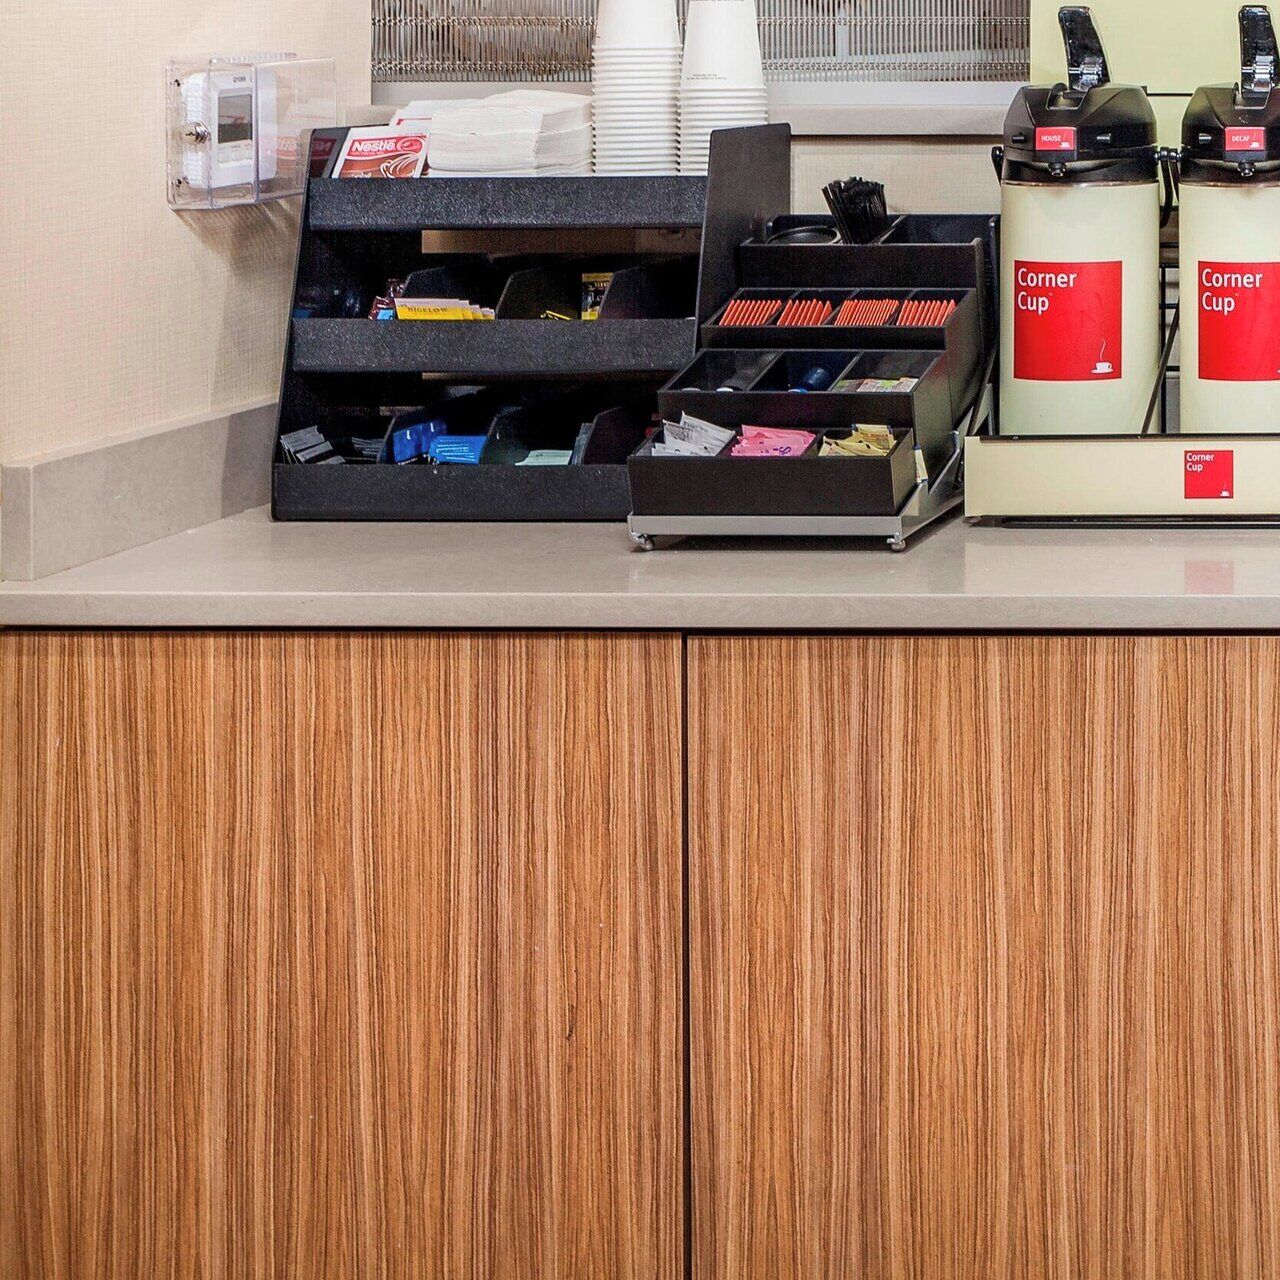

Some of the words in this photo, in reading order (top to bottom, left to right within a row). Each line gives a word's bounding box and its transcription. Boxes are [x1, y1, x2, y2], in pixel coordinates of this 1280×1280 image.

[1040, 134, 1062, 142] HOUSE
[1017, 267, 1078, 288] Corner
[1201, 268, 1264, 289] Corner
[1186, 452, 1215, 461] Corner
[1186, 462, 1203, 473] Cup
